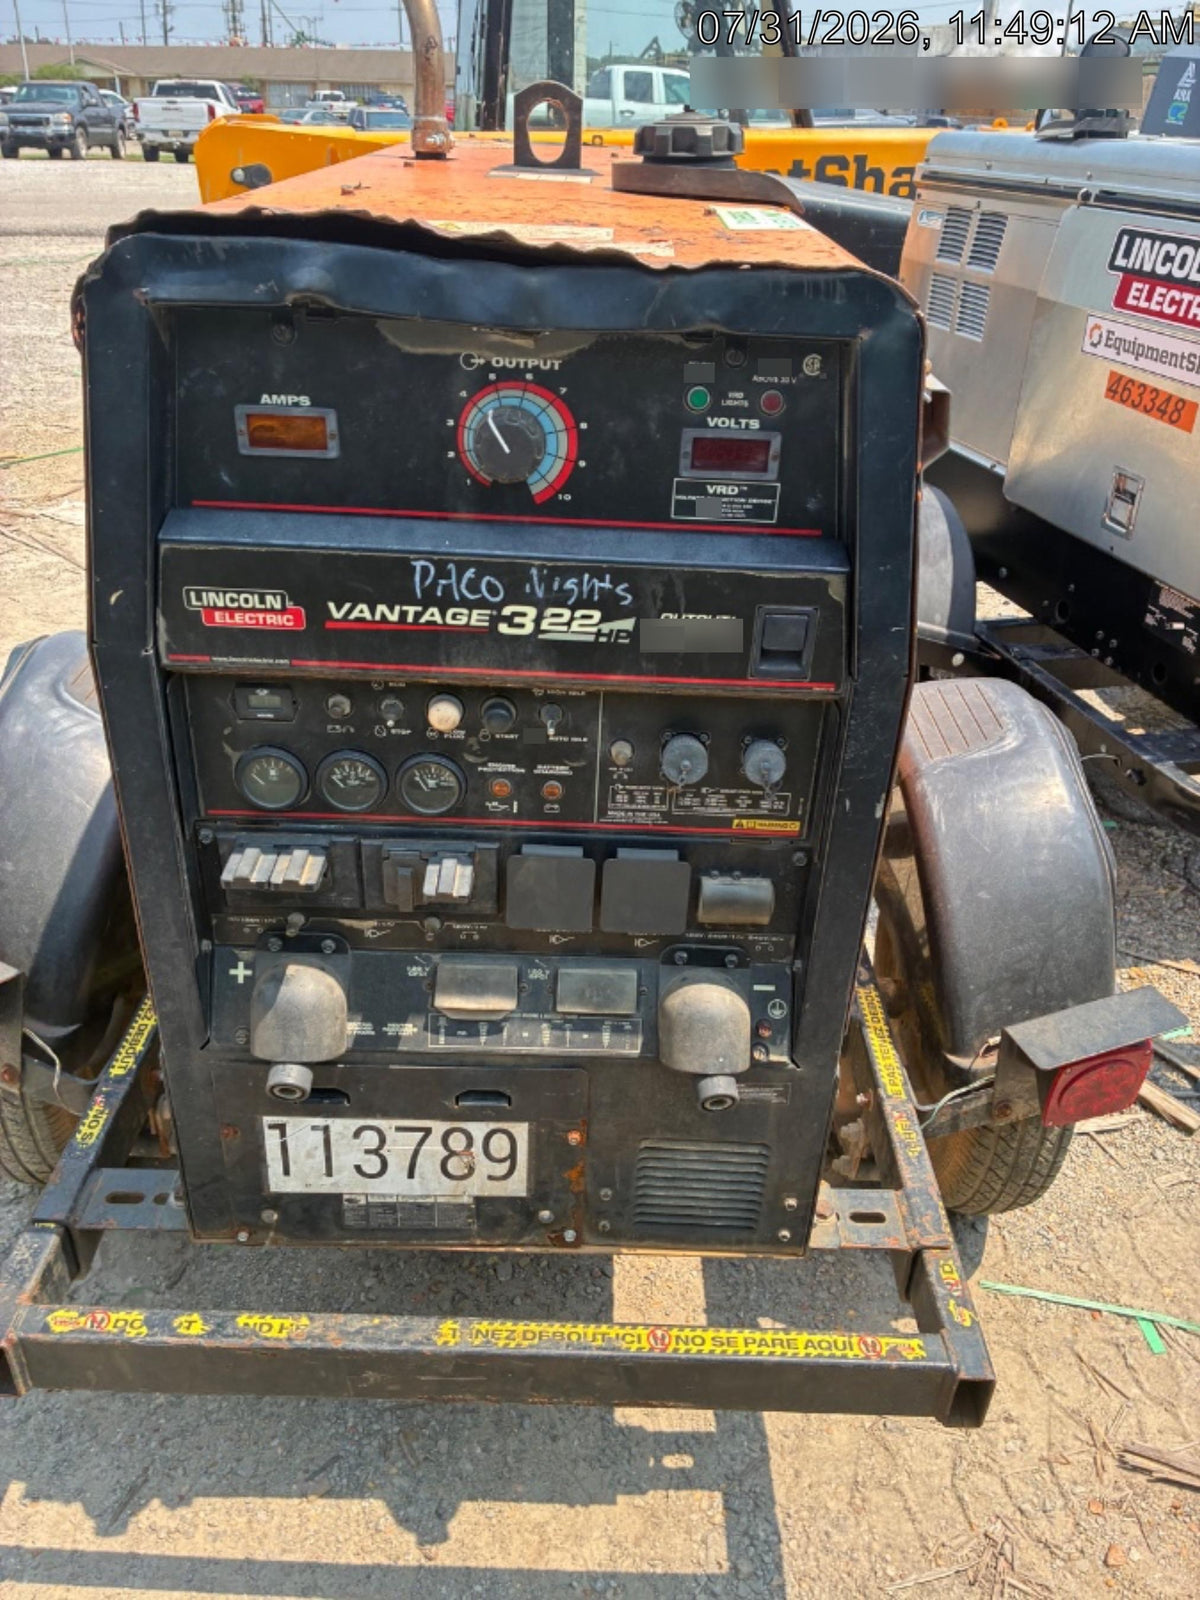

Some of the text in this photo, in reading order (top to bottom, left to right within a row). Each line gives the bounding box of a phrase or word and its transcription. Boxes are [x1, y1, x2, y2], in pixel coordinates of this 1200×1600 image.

[491, 356, 563, 371] OUTPUT
[459, 389, 468, 398] 4
[559, 387, 568, 396] 7
[260, 393, 312, 407] AMPS
[1107, 375, 1187, 425] 463348
[446, 418, 455, 427] 3
[579, 421, 588, 430] 8
[707, 416, 761, 430] VOLTS
[447, 450, 456, 459] 2
[578, 459, 587, 468] 9
[466, 478, 472, 486] 1
[557, 493, 572, 501] 10
[189, 590, 282, 609] LINCOLN
[214, 611, 295, 627] ELECTRIC
[327, 601, 491, 627] VANTAGE
[498, 605, 601, 636] 322
[267, 1122, 519, 1182] 113789
[675, 1334, 854, 1352] NO SE PARE AQUI
